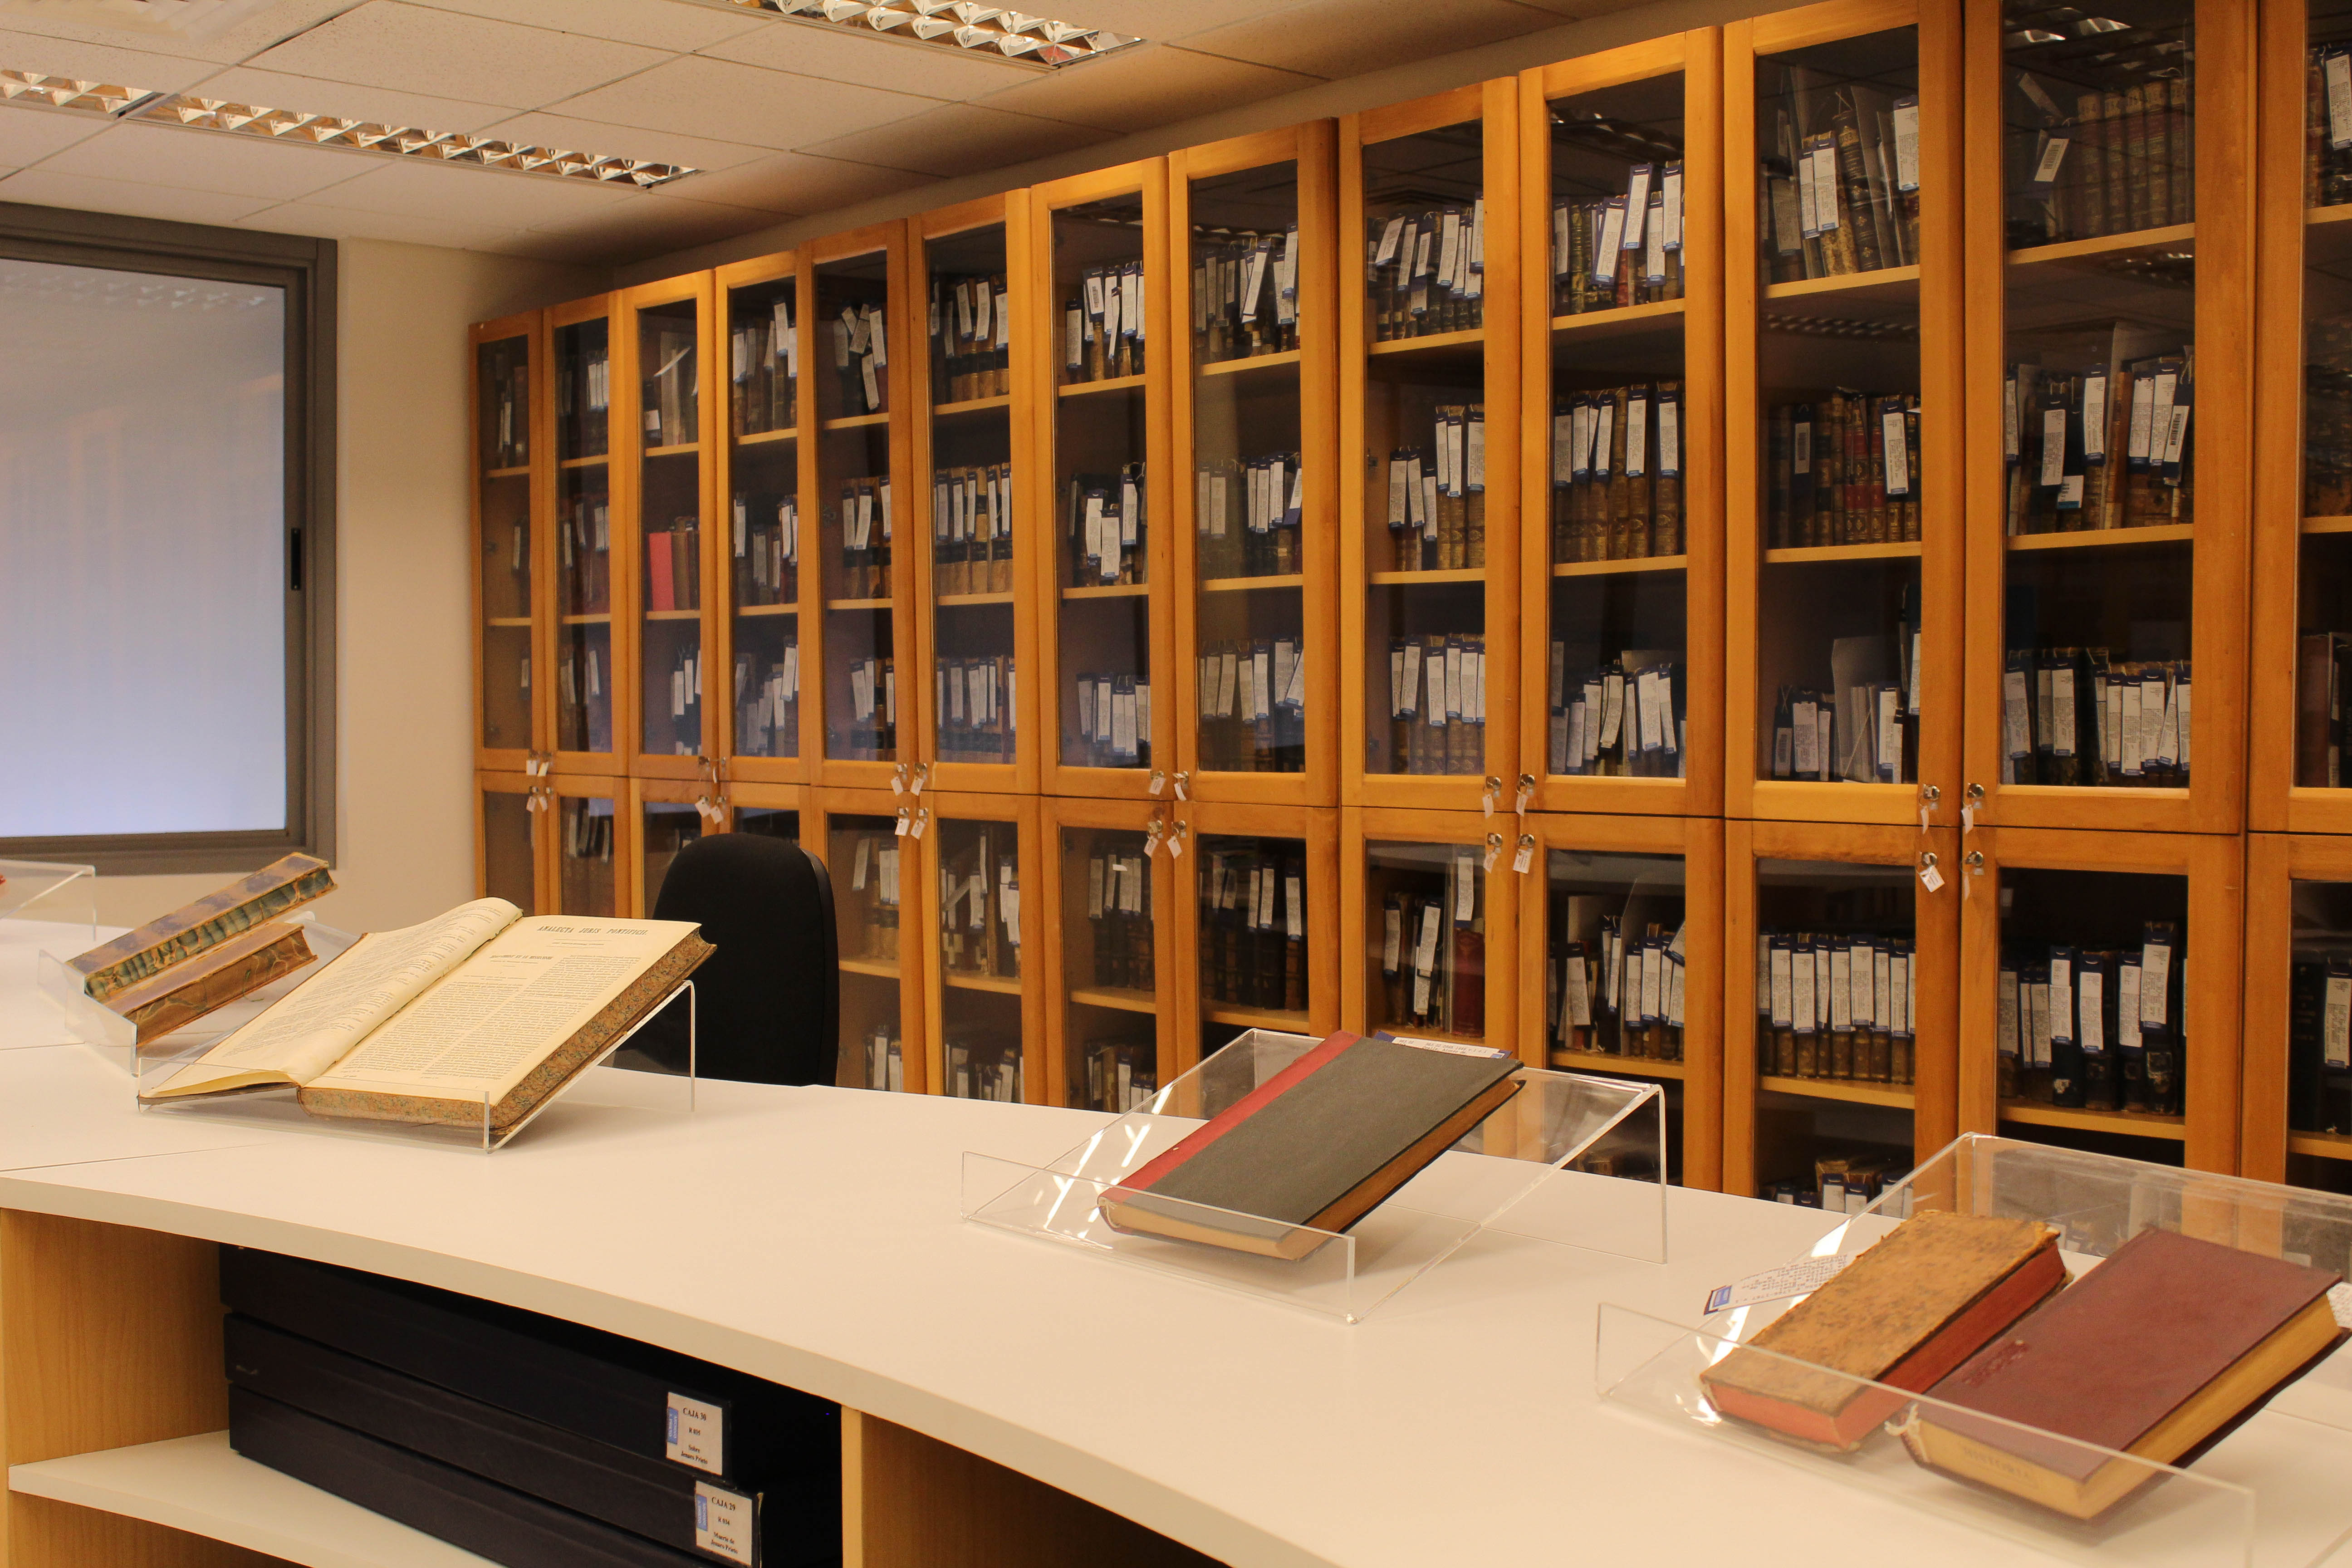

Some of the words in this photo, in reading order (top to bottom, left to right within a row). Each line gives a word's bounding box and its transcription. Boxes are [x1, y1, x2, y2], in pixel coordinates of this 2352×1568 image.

[682, 1407, 699, 1419] CAJA
[700, 1412, 706, 1421] 30
[695, 1455, 708, 1464] Prieto
[711, 1496, 728, 1509] CAJA
[729, 1503, 736, 1511] 29
